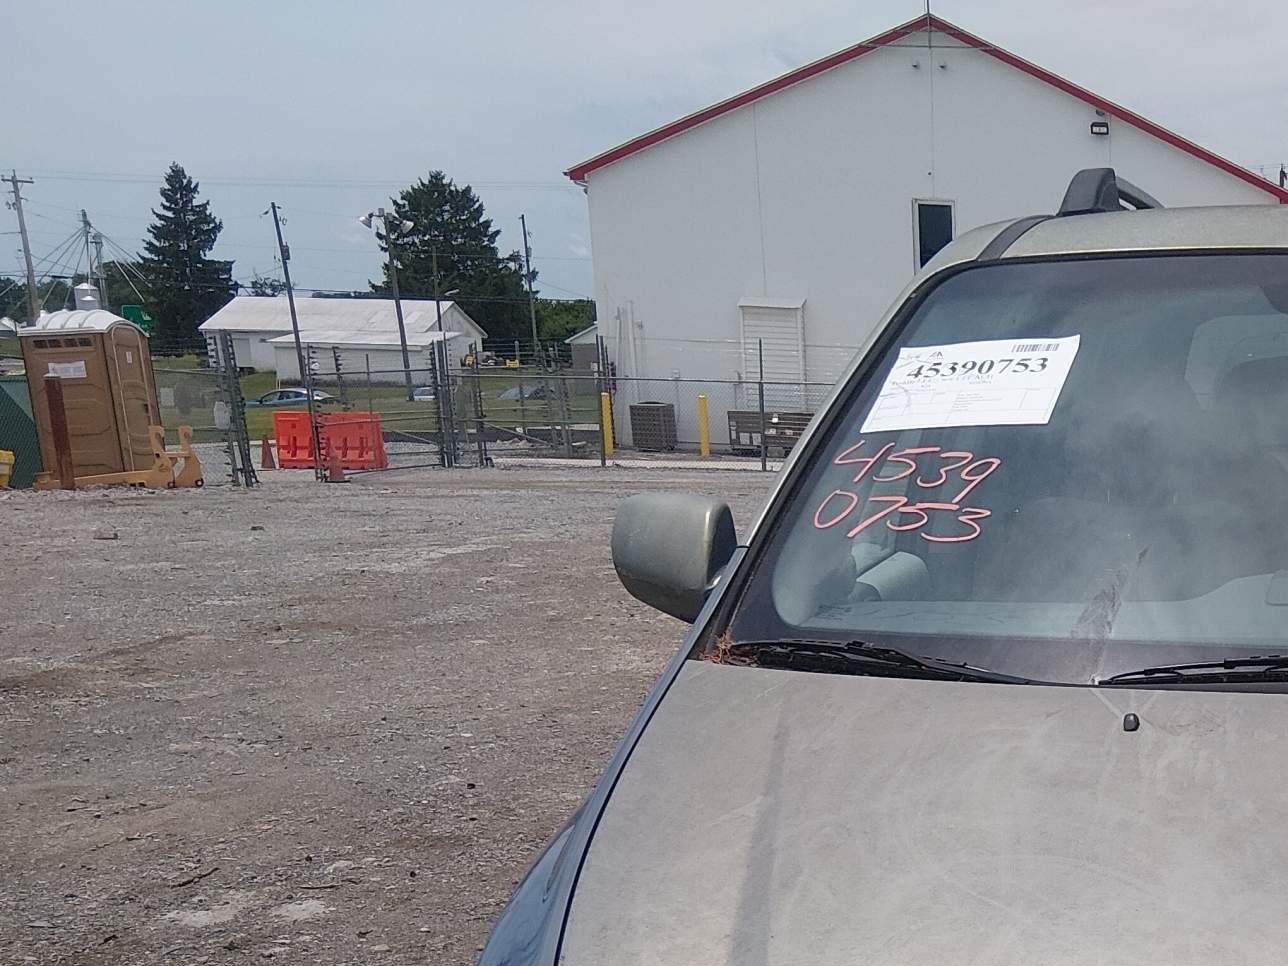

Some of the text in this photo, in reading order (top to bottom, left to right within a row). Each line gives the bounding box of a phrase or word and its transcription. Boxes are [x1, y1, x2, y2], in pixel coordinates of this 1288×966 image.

[907, 357, 1048, 379] 45390753
[834, 440, 1000, 503] 4539
[814, 489, 992, 542] 0753
